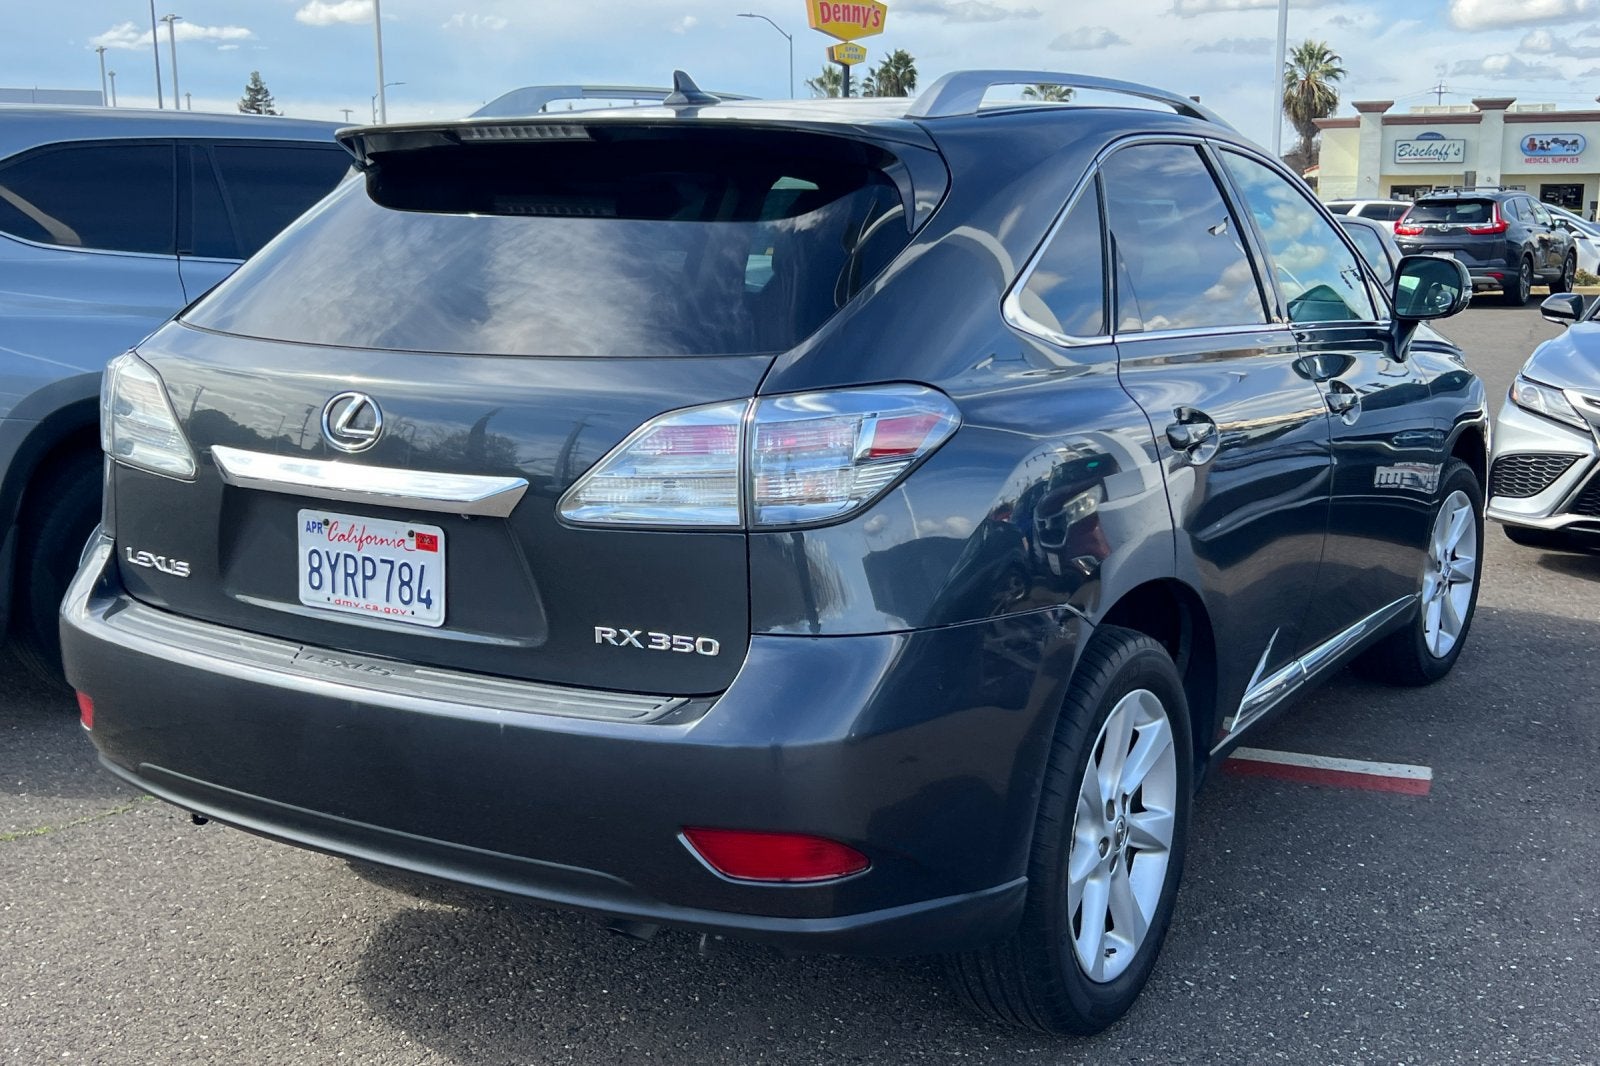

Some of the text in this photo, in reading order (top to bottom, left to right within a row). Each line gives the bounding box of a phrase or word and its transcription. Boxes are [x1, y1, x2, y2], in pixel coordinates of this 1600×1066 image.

[819, 1, 881, 29] Denny's
[1397, 142, 1461, 162] Bischoff's
[305, 520, 323, 535] APR
[327, 520, 416, 552] California
[126, 546, 191, 578] LEXUS
[308, 548, 433, 610] 8YRP784
[334, 598, 407, 616] dmv.ca.gov
[594, 626, 720, 657] RX 350
